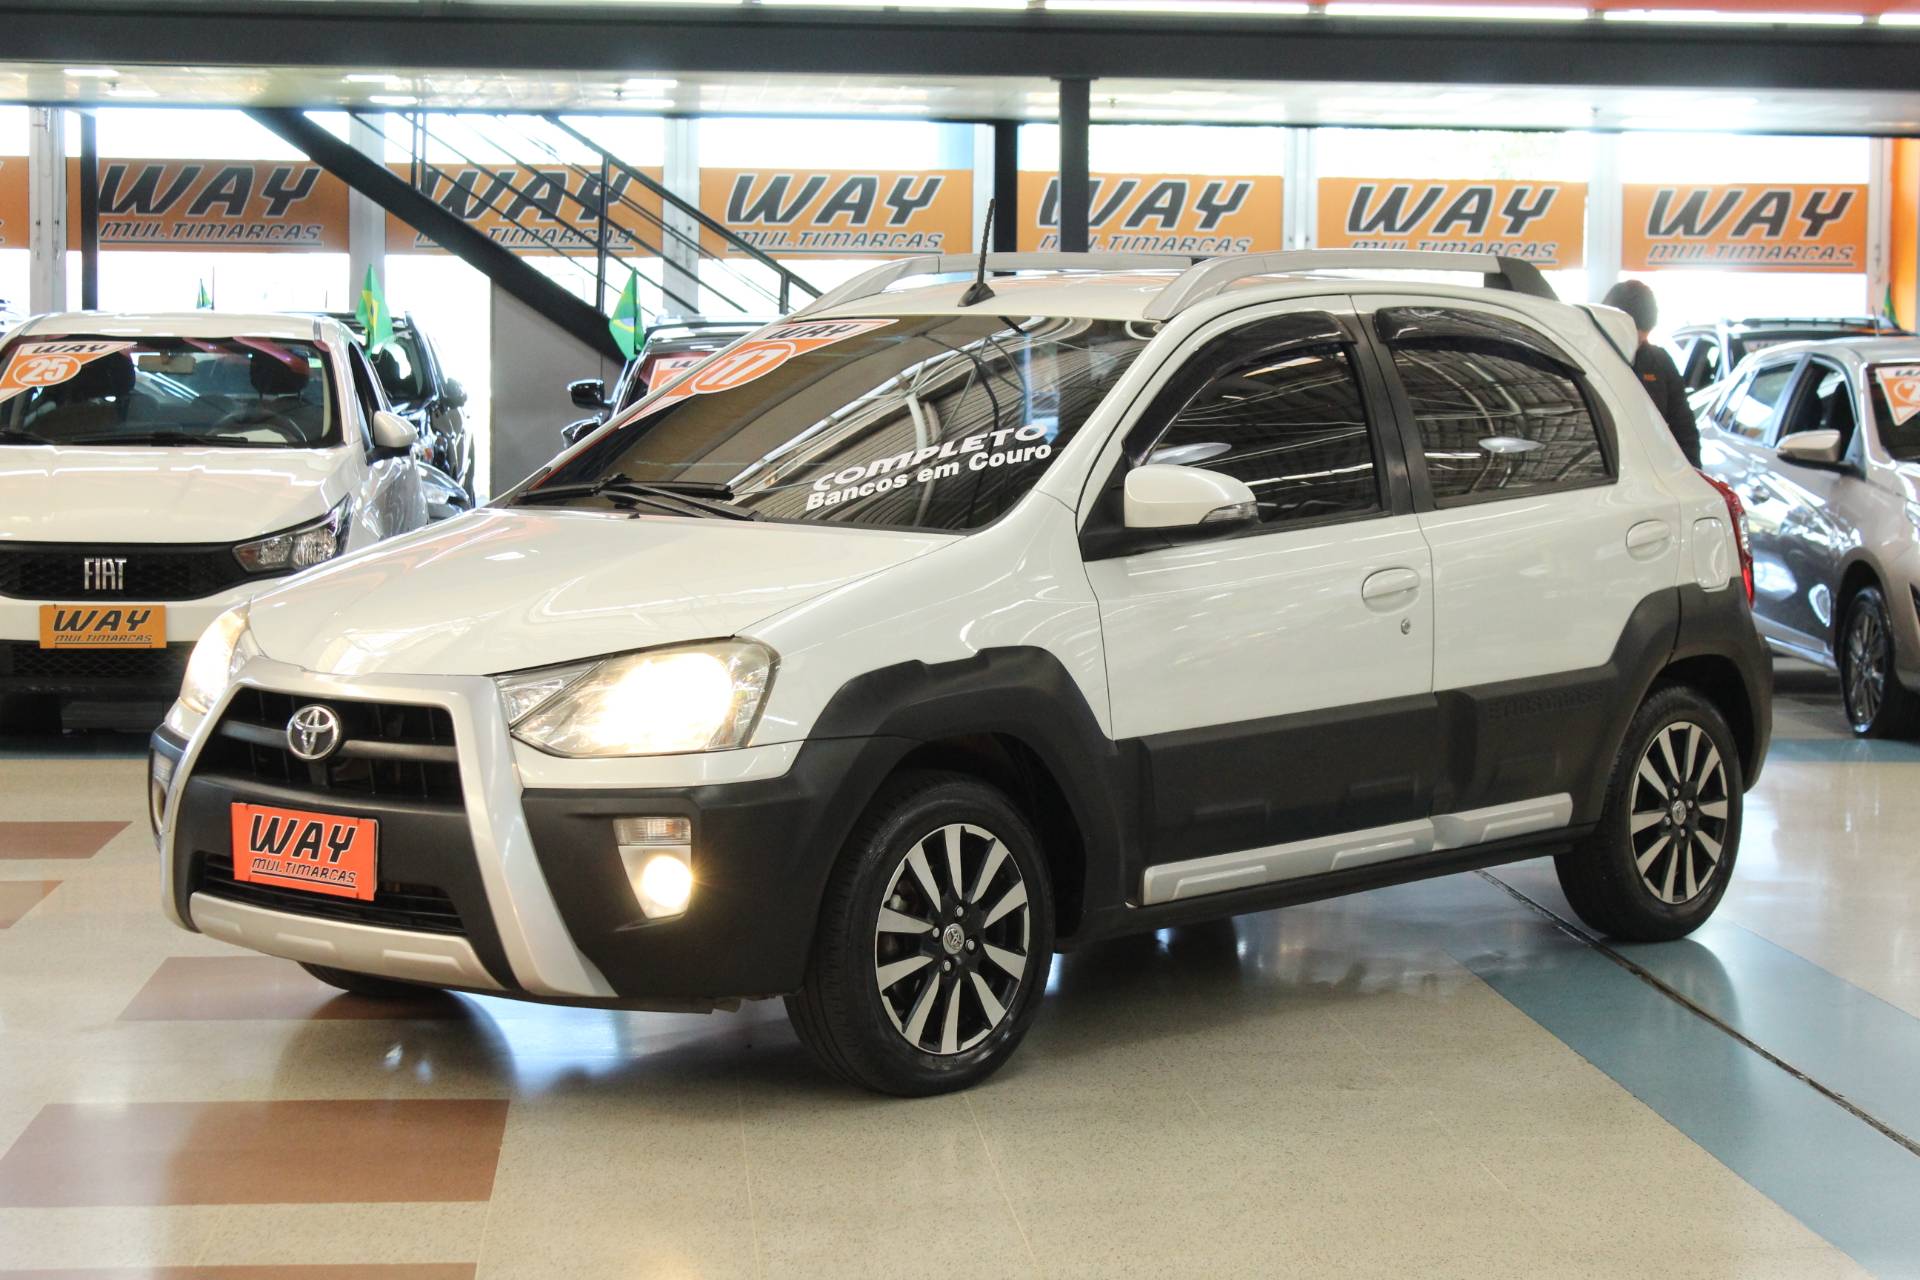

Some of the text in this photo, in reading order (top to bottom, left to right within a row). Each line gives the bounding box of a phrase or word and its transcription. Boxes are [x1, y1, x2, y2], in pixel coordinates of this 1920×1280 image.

[98, 164, 323, 218] WAY
[419, 169, 633, 222] WAY
[726, 173, 945, 226] WAY
[1037, 177, 1254, 232] WAY
[1346, 184, 1559, 237] WAY
[1645, 188, 1856, 239] WAY
[100, 221, 323, 240] MULTIMARCAS
[1039, 233, 1252, 254] MLTIMARCAS
[1649, 243, 1856, 261] MULTIMARCAS
[766, 324, 860, 340] WAY
[31, 344, 109, 354] WAY
[20, 358, 74, 382] 25
[812, 423, 1048, 492] COMPLETO
[805, 444, 1052, 512] Bancos em Couro
[84, 558, 127, 590] FIAT
[53, 609, 152, 632] WAY
[55, 634, 152, 642] MULTIMARCAS
[249, 813, 357, 864] WAY
[252, 857, 356, 884] MULTIMARCAS
